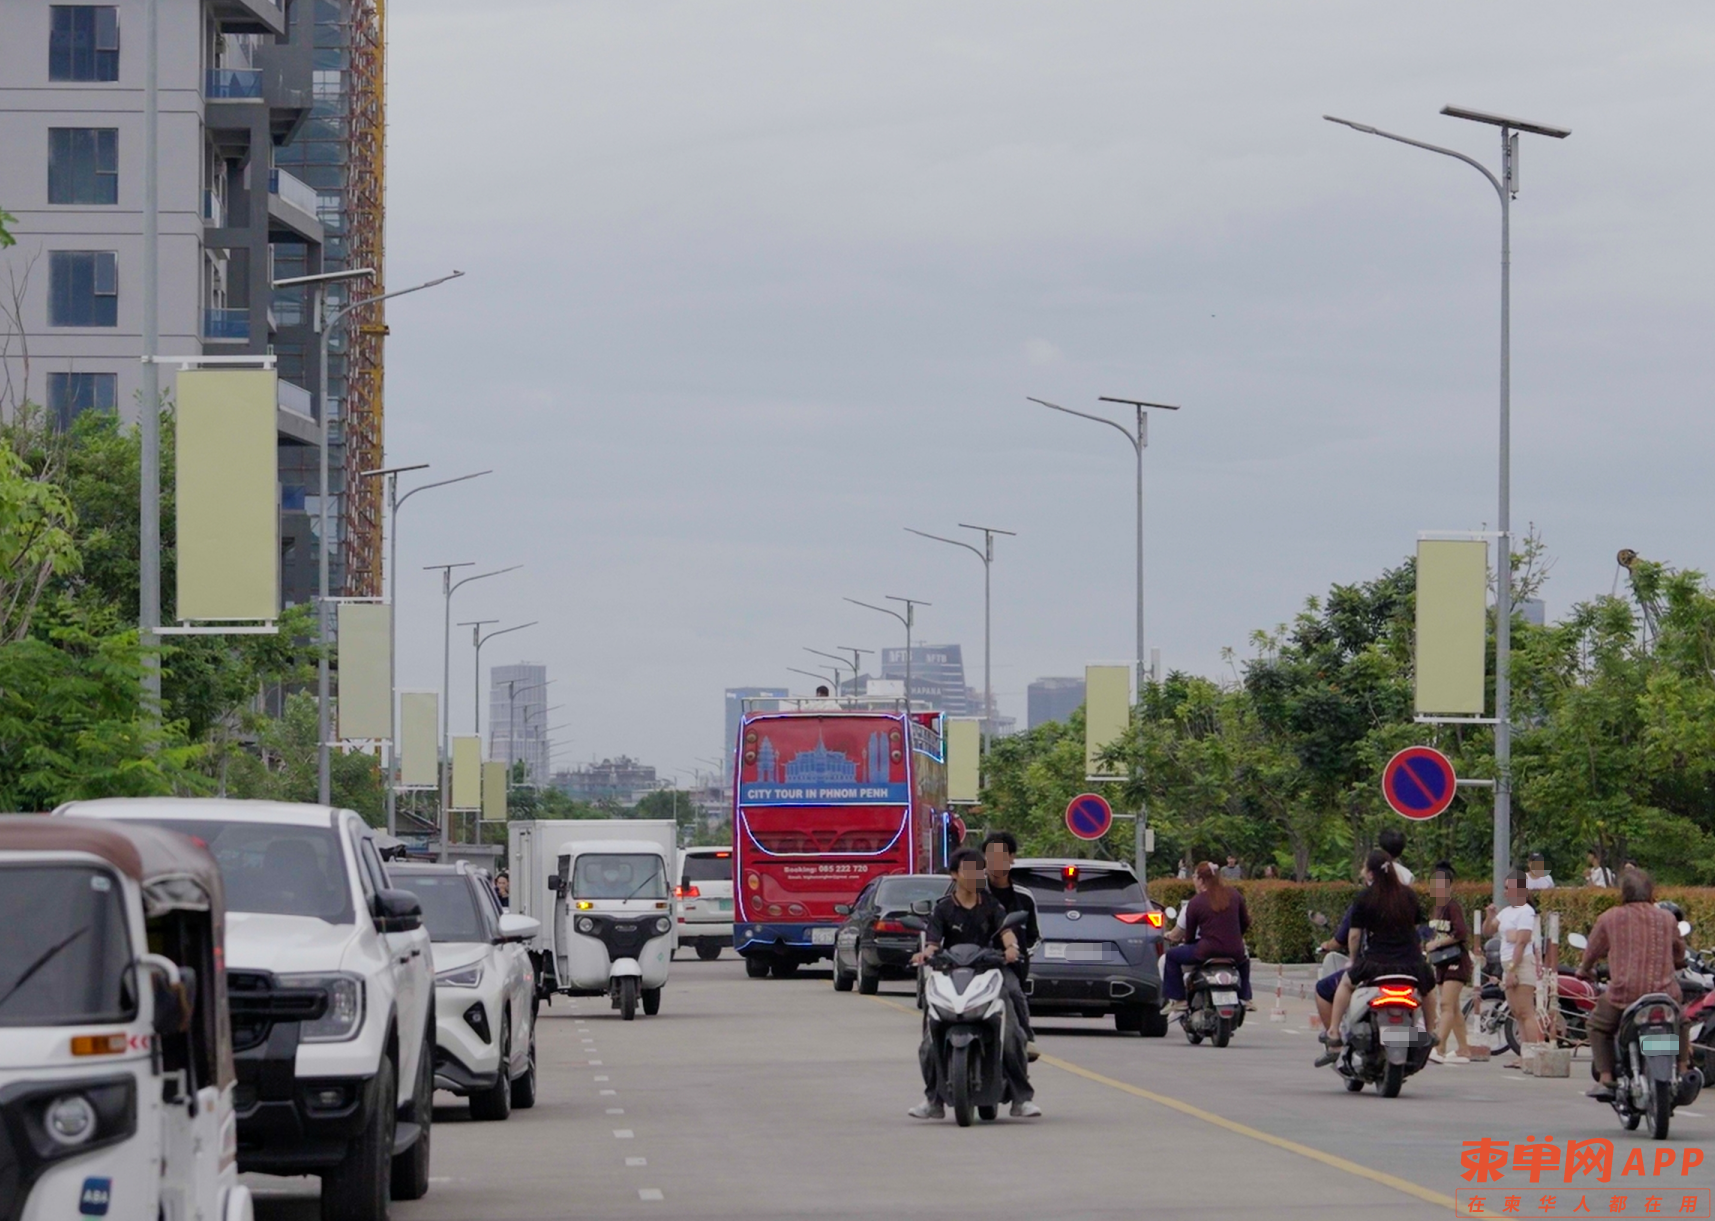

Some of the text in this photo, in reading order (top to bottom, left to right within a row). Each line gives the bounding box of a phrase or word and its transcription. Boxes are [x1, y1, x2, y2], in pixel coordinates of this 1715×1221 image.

[747, 788, 888, 800] CITY TOUR IN PHNOM PENH
[835, 865, 851, 873] 222
[852, 865, 868, 873] 720
[82, 1189, 108, 1204] ABA
